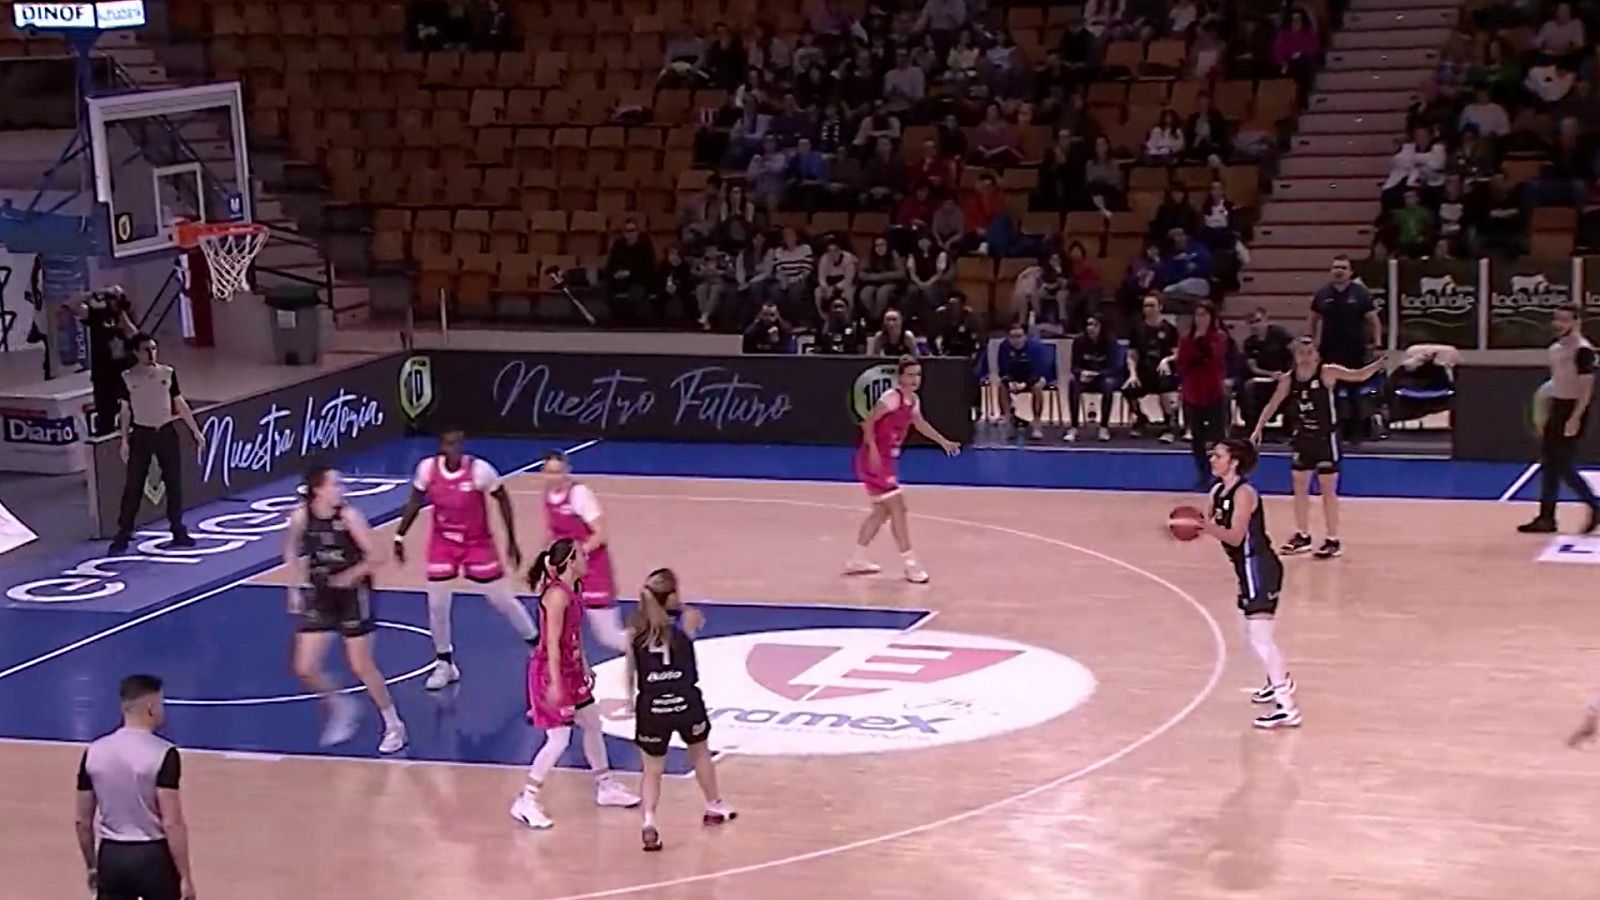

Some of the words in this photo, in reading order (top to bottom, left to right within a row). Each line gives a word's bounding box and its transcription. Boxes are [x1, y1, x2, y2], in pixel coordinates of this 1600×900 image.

[9, 418, 73, 440] Diario
[493, 360, 654, 429] Nuestro
[670, 366, 792, 430] Futuro
[202, 404, 295, 487] Nuestra
